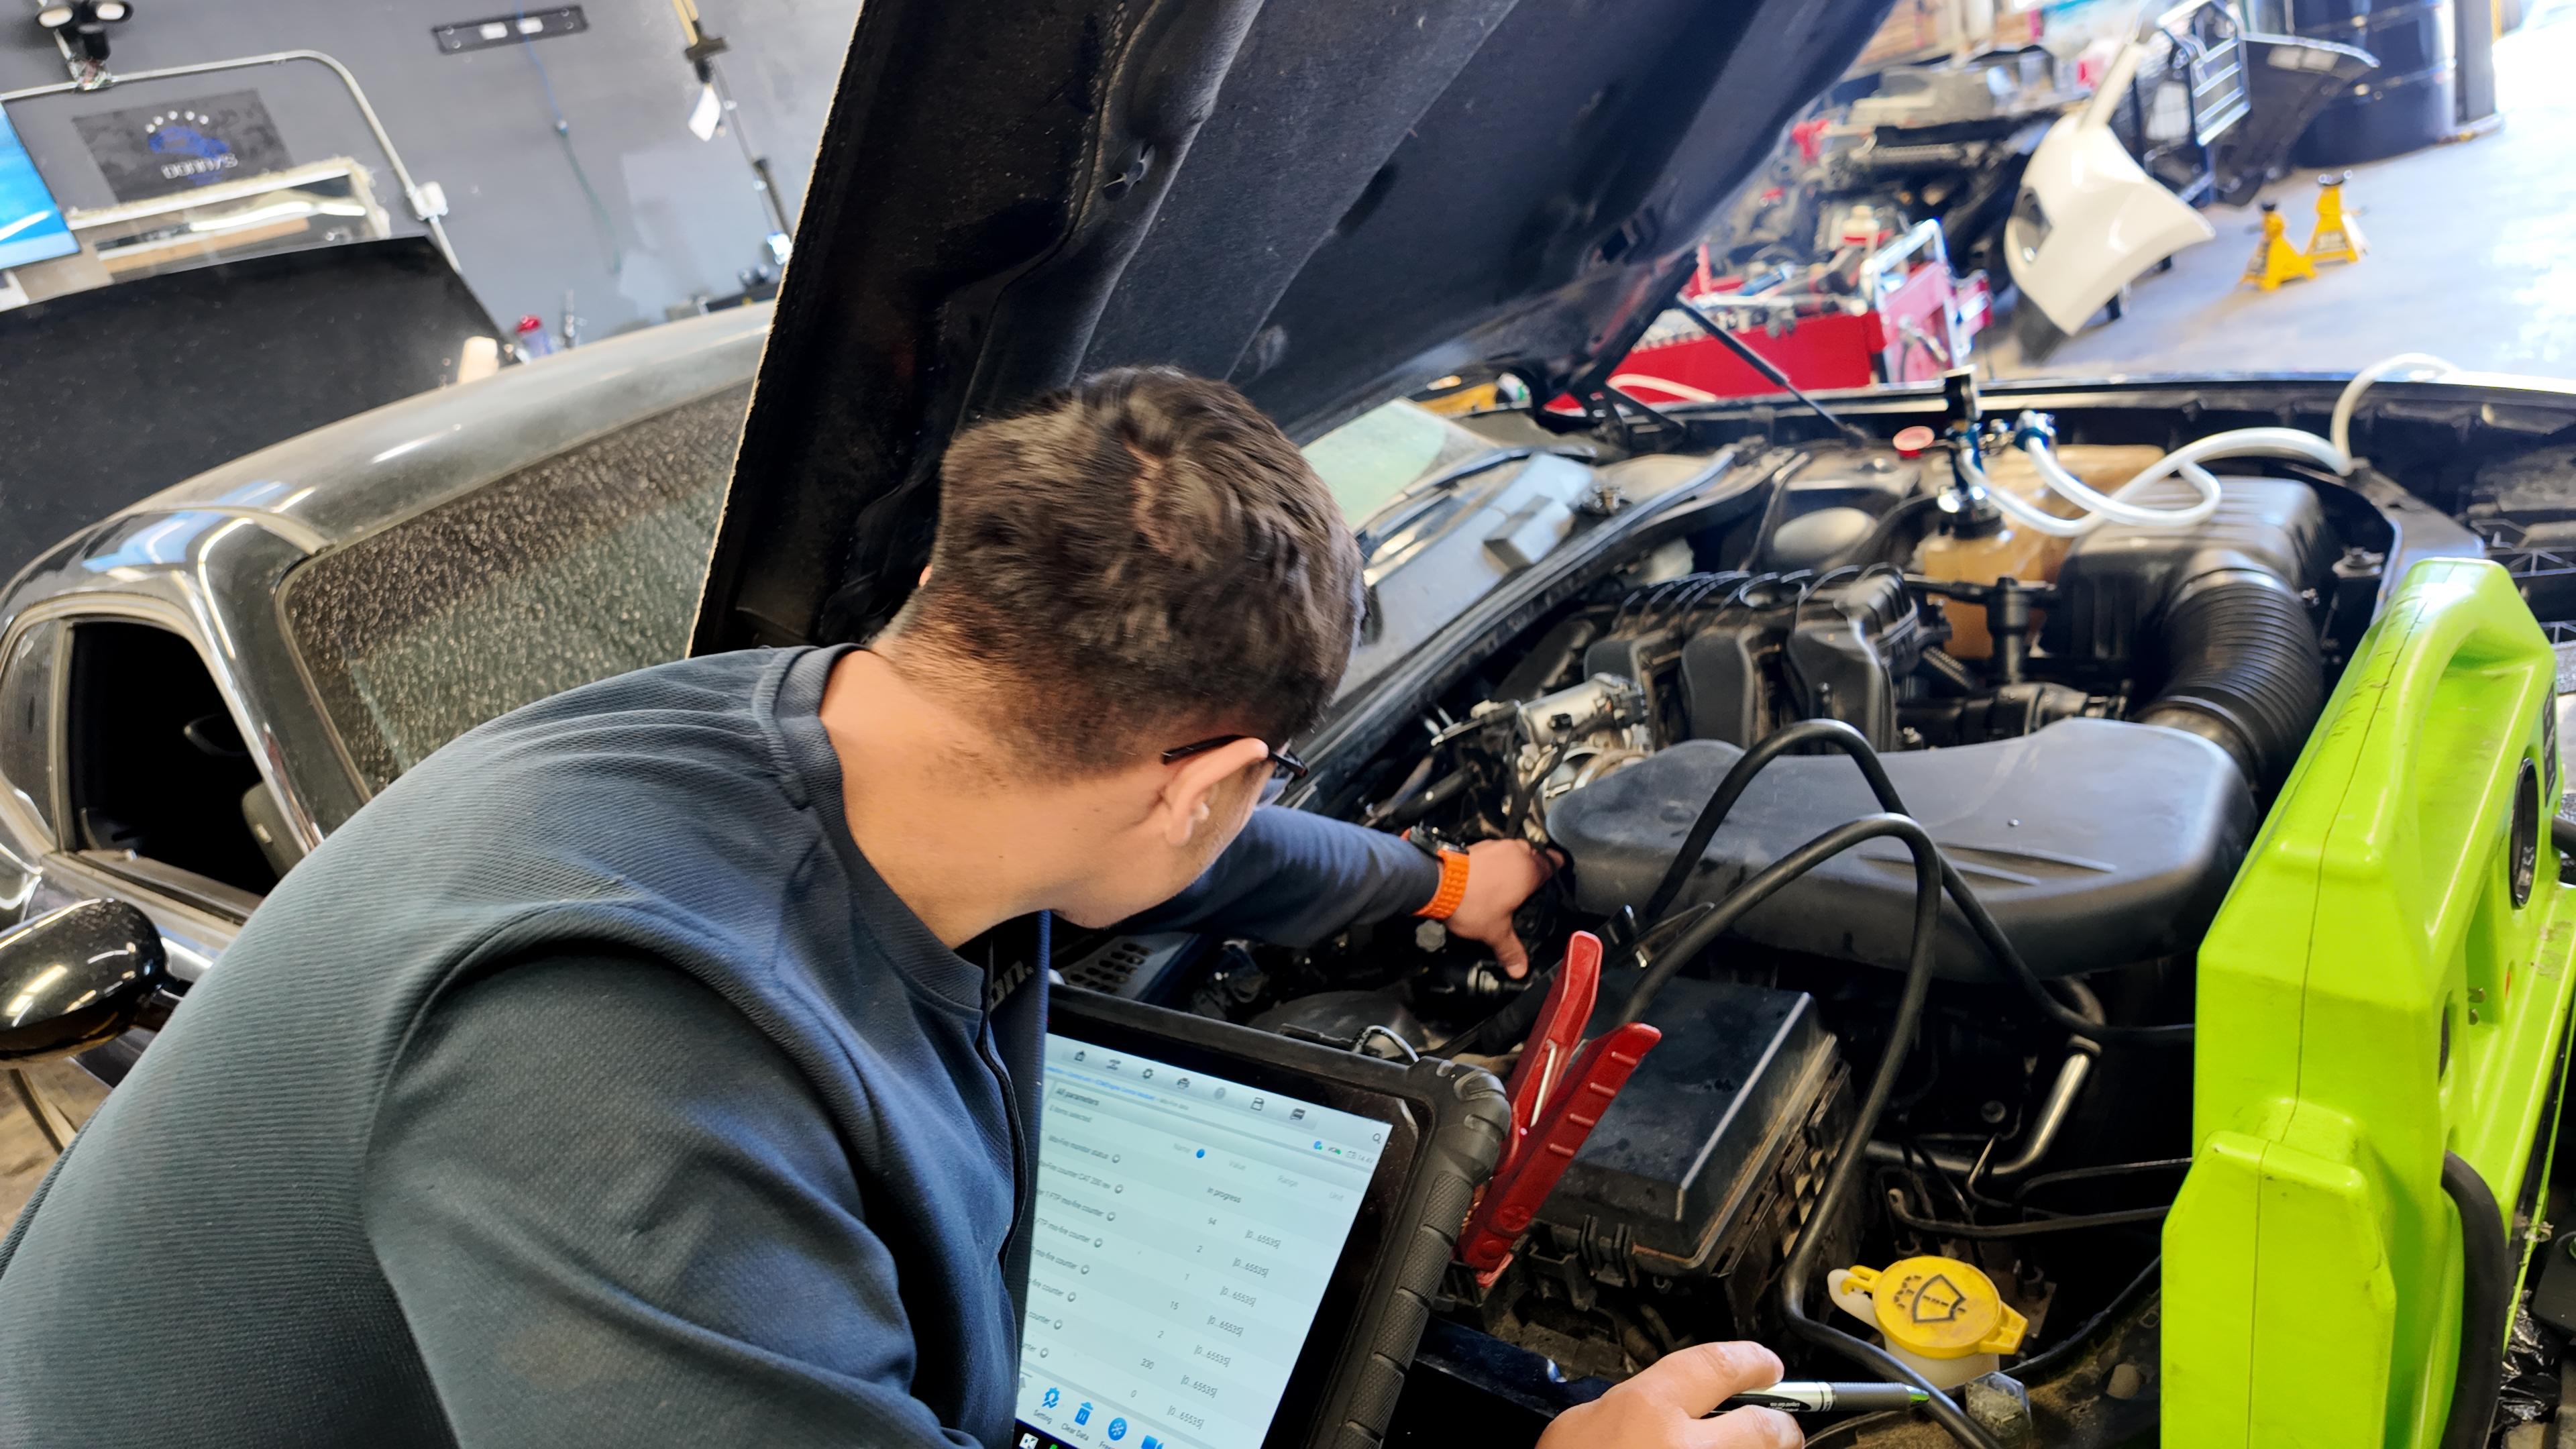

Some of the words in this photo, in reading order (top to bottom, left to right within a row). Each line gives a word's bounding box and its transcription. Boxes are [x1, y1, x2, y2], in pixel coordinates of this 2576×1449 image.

[1065, 1091, 1099, 1106] parameters
[1214, 1190, 1241, 1203] progress
[1081, 1205, 1104, 1217] counter
[1068, 1231, 1091, 1243] counter
[1196, 1245, 1203, 1253] 2
[1055, 1257, 1079, 1269] counter
[1042, 1284, 1065, 1297] counter
[1170, 1301, 1179, 1310] 15
[1028, 1311, 1052, 1324] counter
[1157, 1330, 1165, 1339] 2
[1130, 1389, 1137, 1398] 0
[1033, 1409, 1053, 1425] Setting
[1061, 1422, 1077, 1435] Clear
[1075, 1430, 1089, 1442] Data
